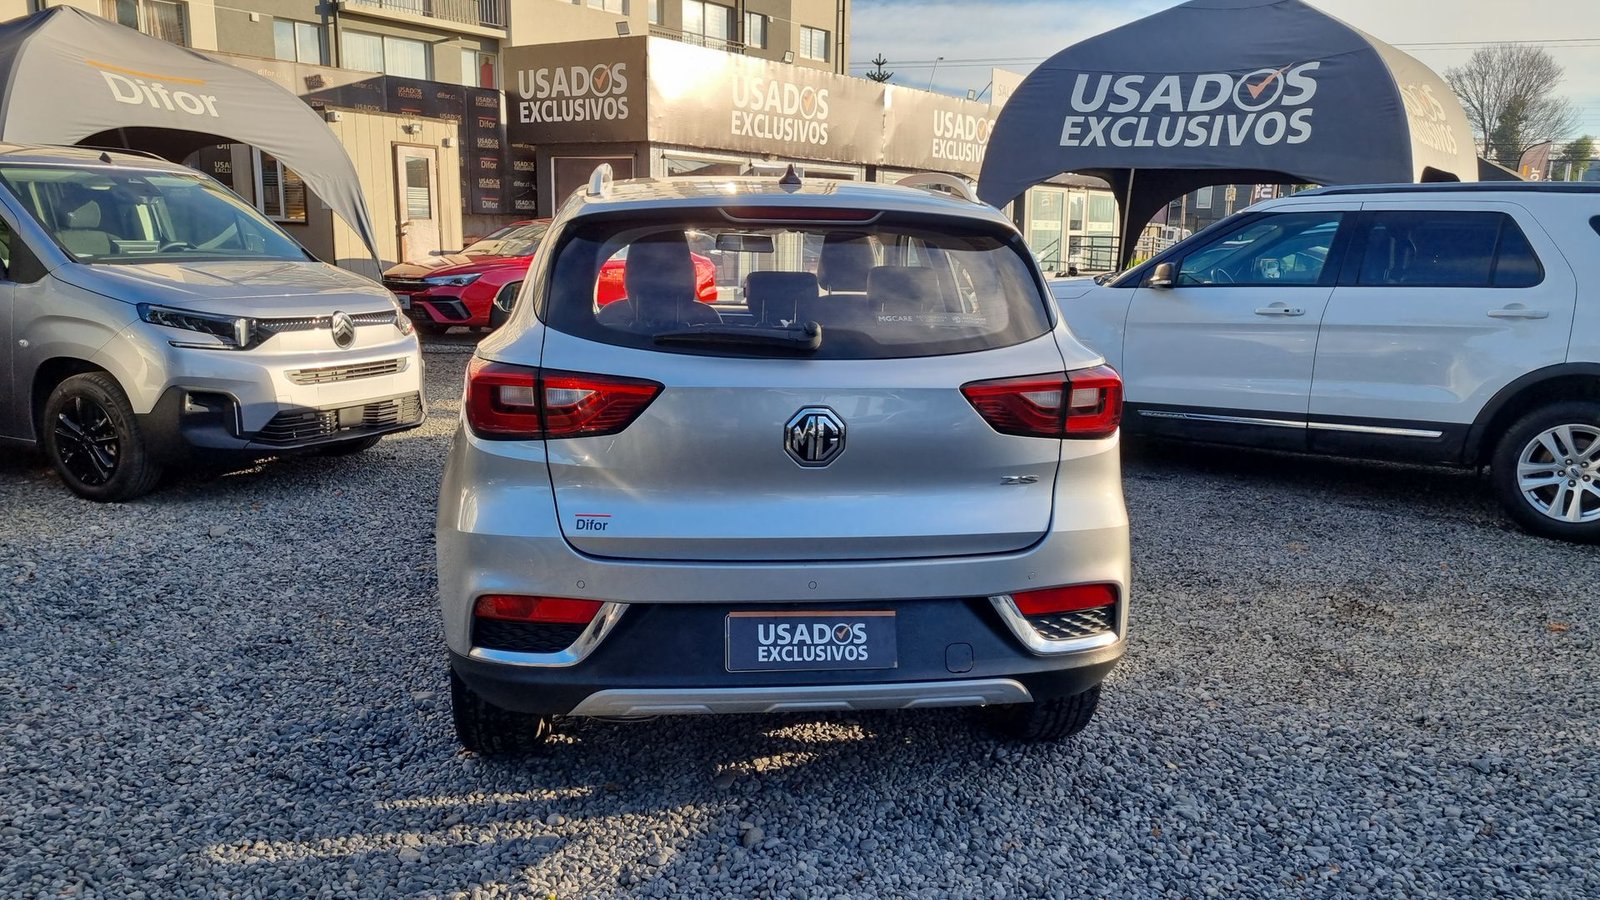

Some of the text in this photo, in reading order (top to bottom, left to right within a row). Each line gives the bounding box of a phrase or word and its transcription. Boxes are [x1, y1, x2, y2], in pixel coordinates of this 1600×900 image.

[100, 70, 219, 117] Difor
[518, 62, 628, 99] USADOS
[1070, 62, 1320, 113] USADOS
[520, 97, 629, 124] EXCLUSIVOS
[731, 75, 829, 120] USADOS
[480, 120, 496, 128] Difor
[731, 110, 828, 145] EXCLUSIVOS
[1059, 108, 1314, 147] EXCLUSIVOS
[932, 138, 986, 163] EXCLUSIV
[481, 161, 497, 169] Difor
[482, 200, 498, 209] Difor
[791, 413, 840, 461] MG
[576, 519, 609, 531] Difor
[757, 622, 868, 645] USADOS
[757, 645, 869, 662] EXCLUSIVOS
